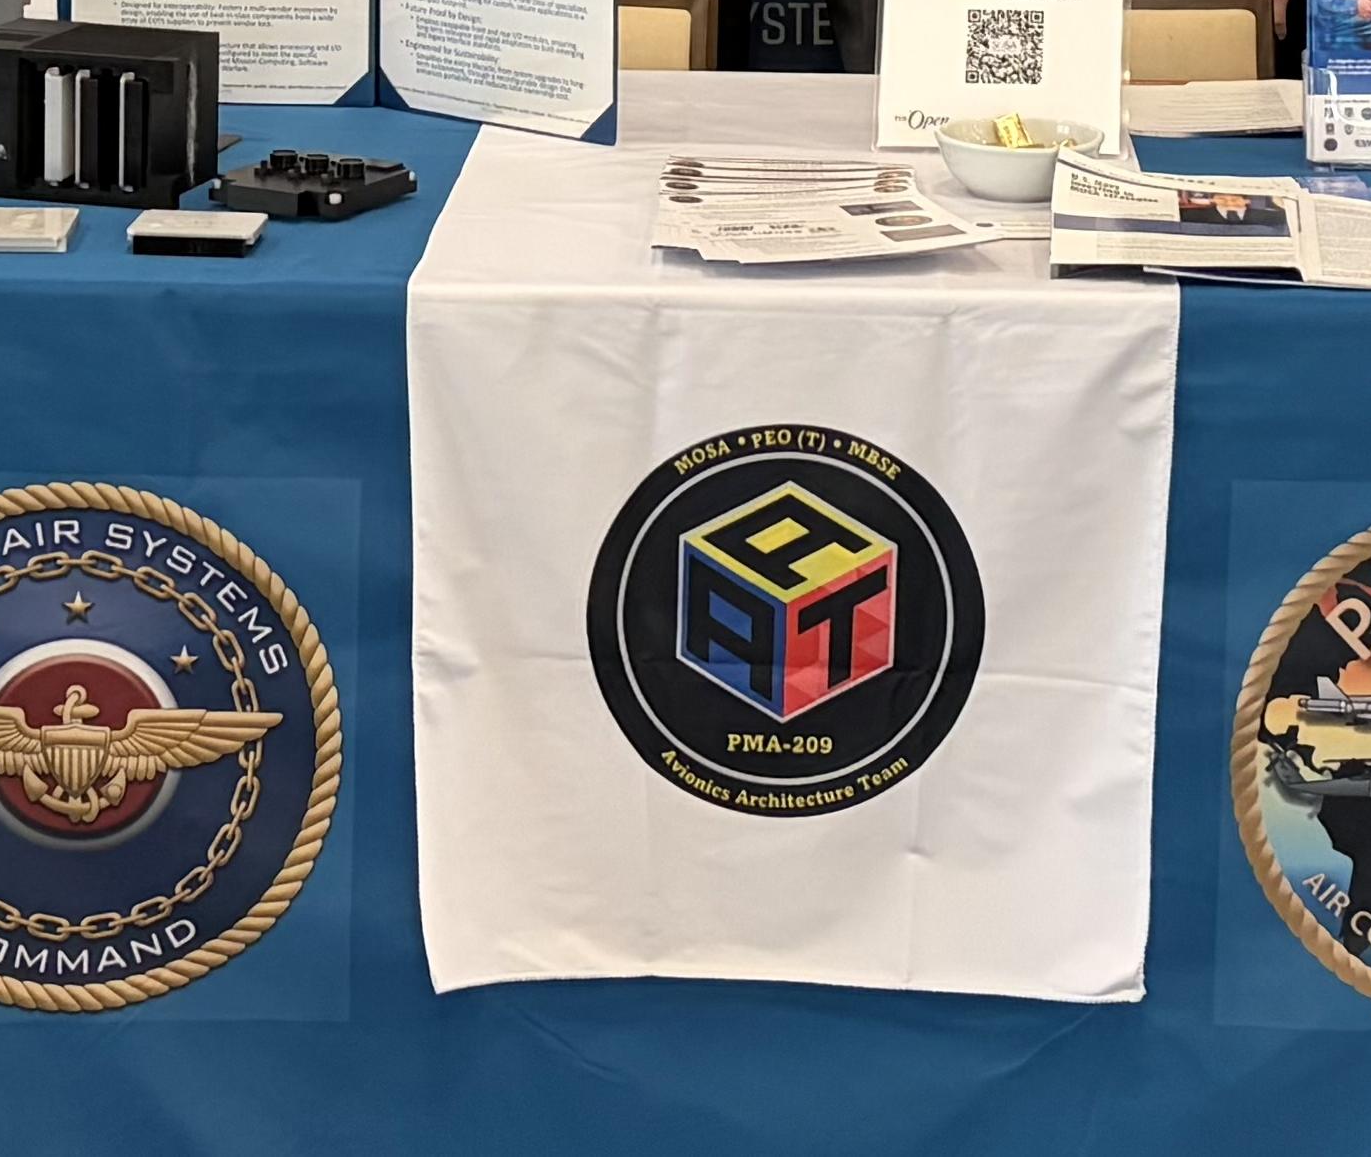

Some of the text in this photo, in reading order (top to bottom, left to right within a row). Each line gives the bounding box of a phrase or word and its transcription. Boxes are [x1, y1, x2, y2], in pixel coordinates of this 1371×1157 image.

[674, 429, 902, 481] MOSA PEO (T) MBSE
[2, 518, 81, 555] AIR
[104, 522, 289, 675] SYSTEMS
[726, 733, 834, 755] PMA-209
[661, 749, 909, 810] Avionics Architecture Team
[1302, 873, 1350, 920] AIR
